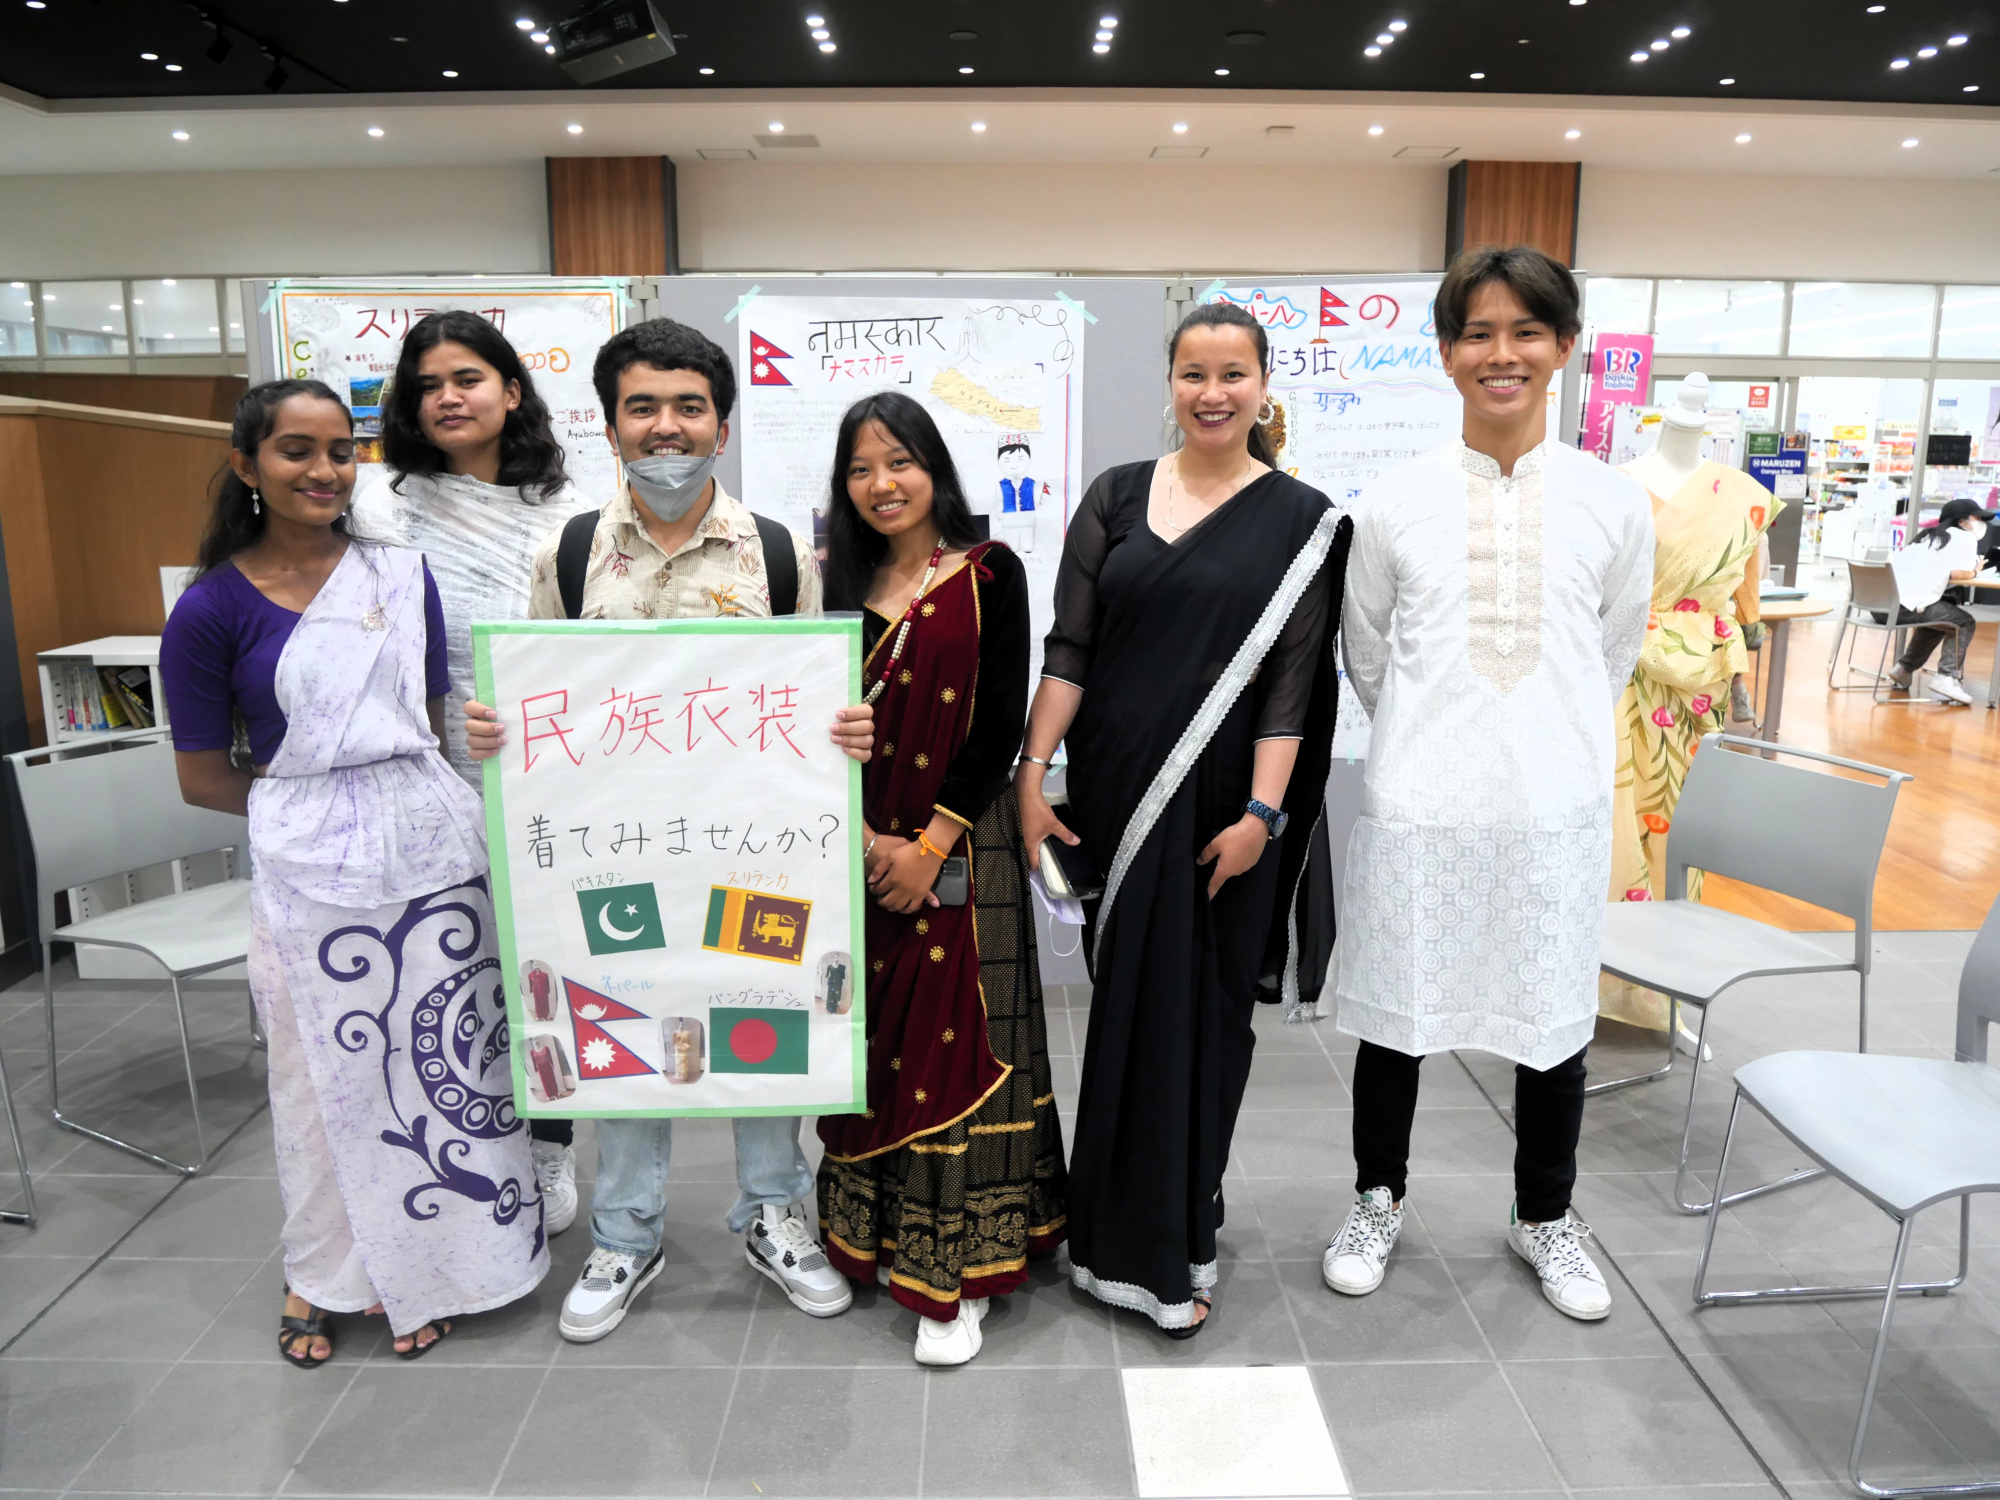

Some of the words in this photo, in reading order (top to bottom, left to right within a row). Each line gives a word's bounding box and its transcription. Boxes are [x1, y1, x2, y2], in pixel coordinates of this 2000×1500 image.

[1359, 295, 1400, 329] の
[808, 316, 946, 354] नमस्कार
[1605, 348, 1642, 374] BR
[1605, 373, 1635, 382] baskin
[1605, 381, 1635, 390] robbins
[959, 390, 998, 413] NEPAL
[556, 408, 596, 425] ご挨拶
[1288, 391, 1299, 458] GUNDRUK
[1761, 459, 1801, 468] MARUZEN
[521, 677, 806, 773] 民族衣装
[527, 813, 840, 868] 着てみませんか?
[571, 871, 625, 890] パキスタン
[727, 870, 789, 891] スリランカ
[601, 974, 656, 995] ネパール
[708, 987, 804, 1007] バングラデシュ
